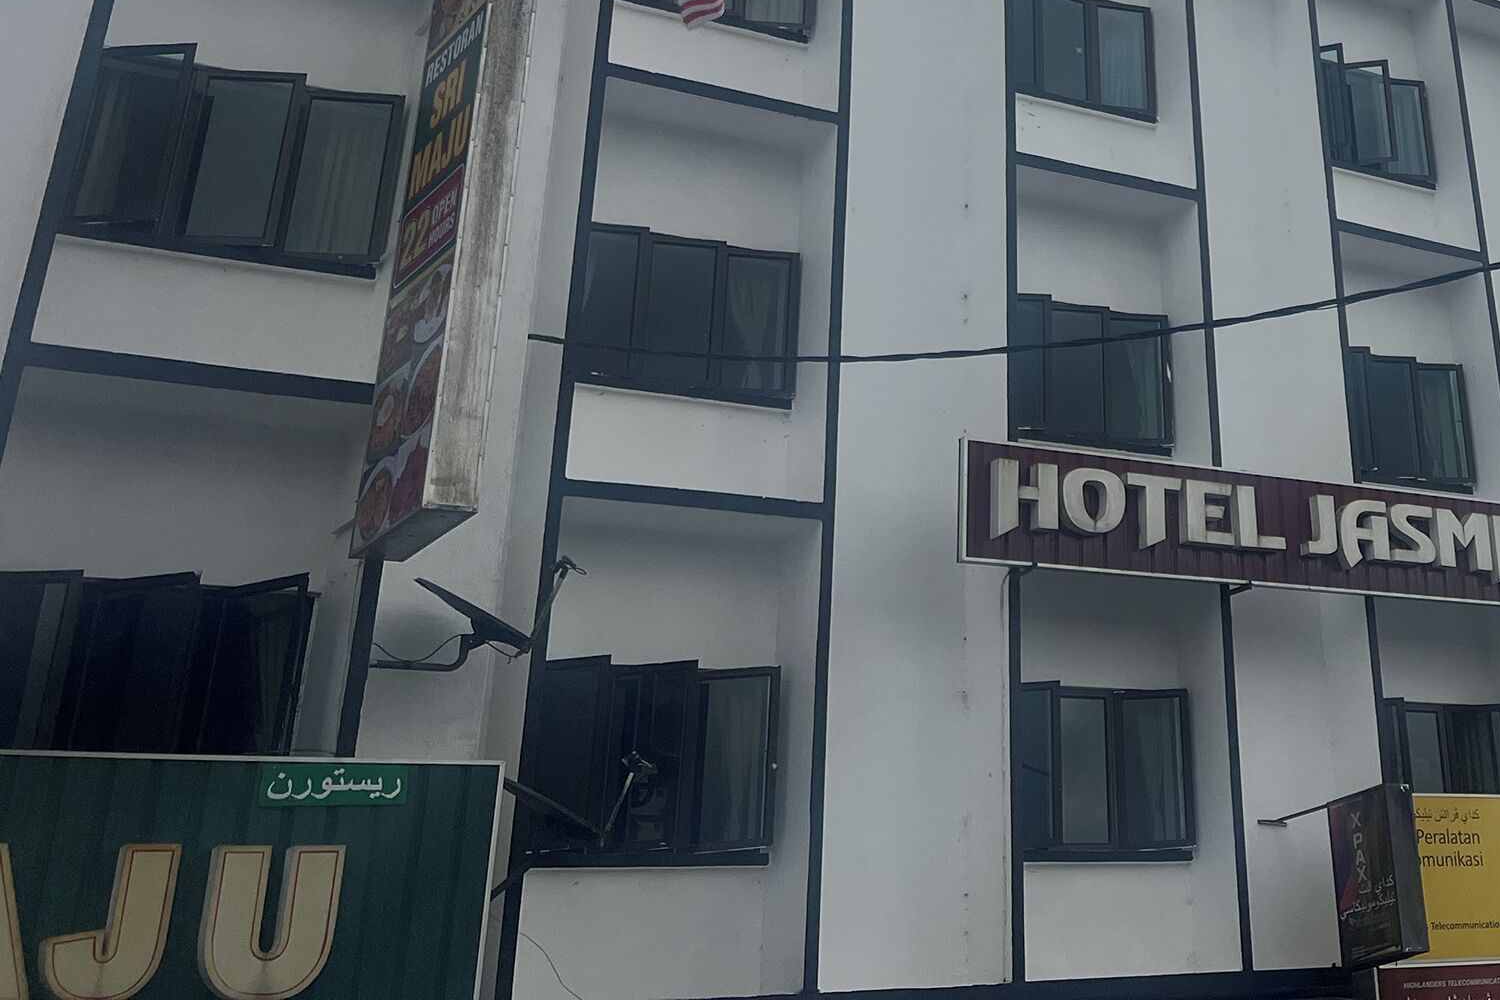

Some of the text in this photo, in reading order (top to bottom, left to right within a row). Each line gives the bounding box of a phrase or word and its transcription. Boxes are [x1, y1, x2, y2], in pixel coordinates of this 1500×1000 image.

[424, 10, 484, 88] RESTORAN
[430, 58, 467, 129] SRI
[408, 103, 471, 200] MAJU
[427, 211, 456, 250] HOURS
[431, 187, 458, 225] OPEN
[989, 457, 1287, 552] HOTEL
[266, 767, 402, 800] ريستورن
[1350, 811, 1368, 883] XPAX
[1416, 827, 1481, 845] Peralatan
